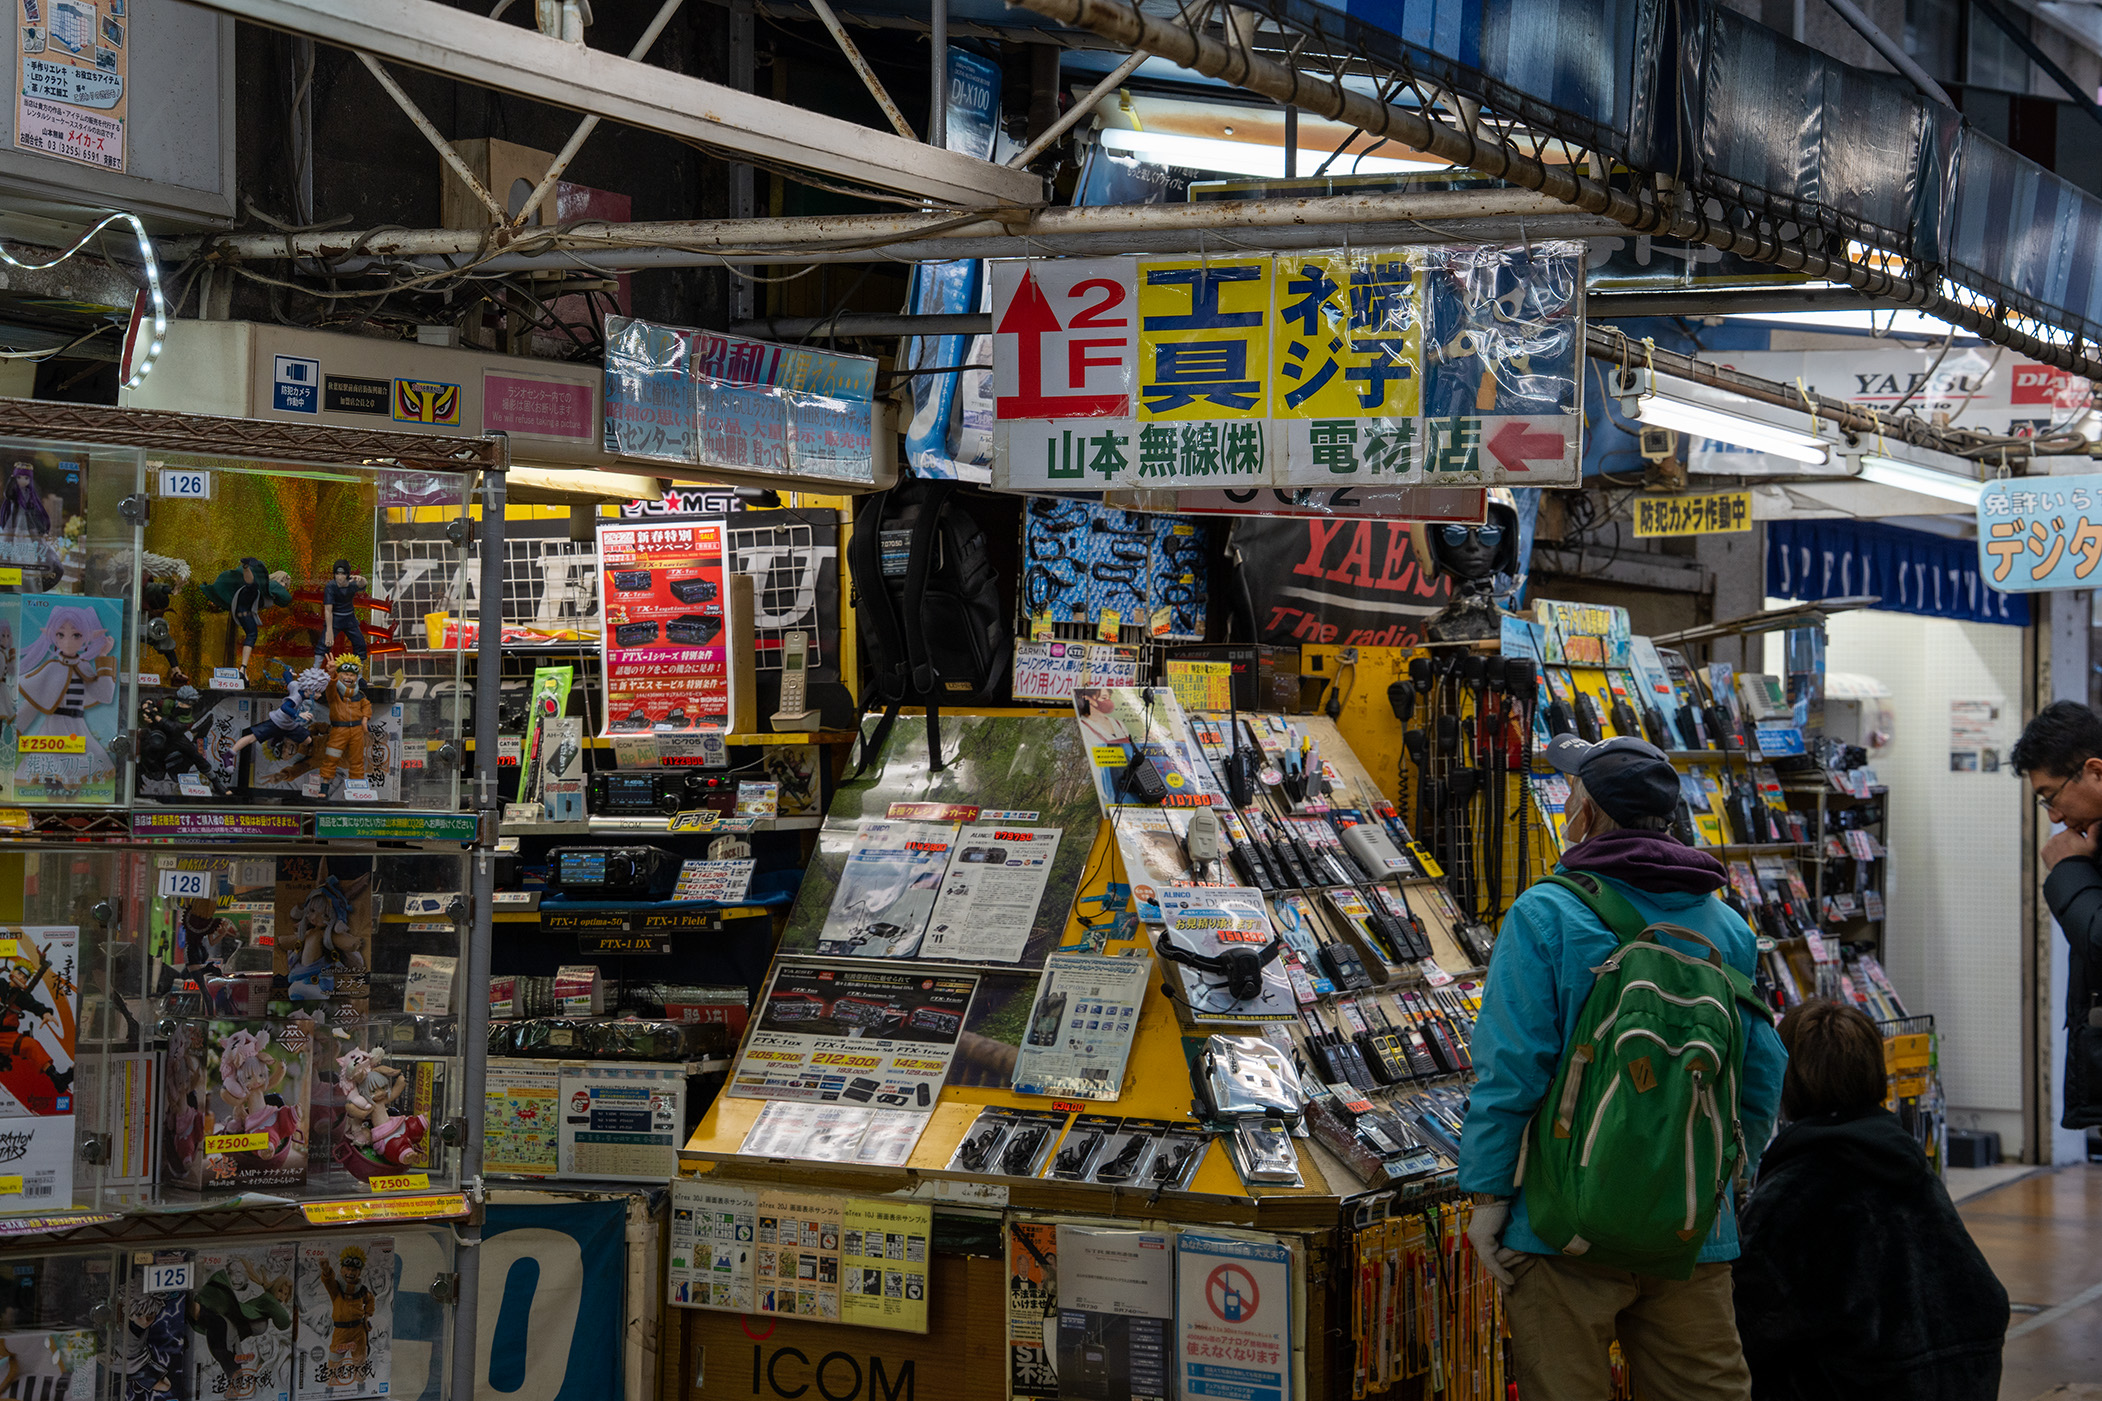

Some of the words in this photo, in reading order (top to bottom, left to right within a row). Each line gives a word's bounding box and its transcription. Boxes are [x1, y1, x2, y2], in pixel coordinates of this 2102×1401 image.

[951, 78, 991, 111] DJ-X100
[67, 130, 105, 151] メイカーズ
[1142, 265, 1264, 413] 工具
[280, 385, 312, 397] 防犯カメラ
[507, 386, 572, 403] ラジオセンター内での
[286, 396, 305, 408] 作動中
[492, 411, 502, 421] We
[515, 413, 535, 425] refuse
[536, 416, 555, 428] taking
[170, 475, 202, 493] 126
[1640, 494, 1746, 535] 防犯カメラ作動中
[637, 529, 693, 544] 新春特別
[638, 543, 693, 552] キャンペーン
[27, 599, 50, 608] TAITO
[1264, 605, 1338, 644] The
[681, 650, 713, 661] 特別条件
[1017, 645, 1047, 657] GARMIN
[20, 739, 65, 750] ¥2500
[671, 738, 701, 746] IC-705
[671, 811, 717, 830] FT8
[170, 874, 201, 894] 128
[1163, 891, 1191, 899] ALINCO
[549, 917, 579, 926] FTX-1
[645, 915, 678, 926] FTX-1
[681, 915, 707, 926] Field
[600, 938, 632, 949] FTX-1
[636, 939, 652, 949] DX
[208, 1137, 250, 1150] ¥2500
[370, 1178, 411, 1190] ¥2500
[674, 1193, 692, 1202] eTrex
[705, 1196, 755, 1208] 画面表示サンプル
[759, 1201, 776, 1210] eTrex
[789, 1204, 841, 1217] 画面表示サンプル
[844, 1208, 862, 1217] eTrex
[875, 1212, 928, 1225] 画面表示サンプル
[154, 1268, 186, 1287] 125
[1187, 1342, 1280, 1366] 使えなくなります
